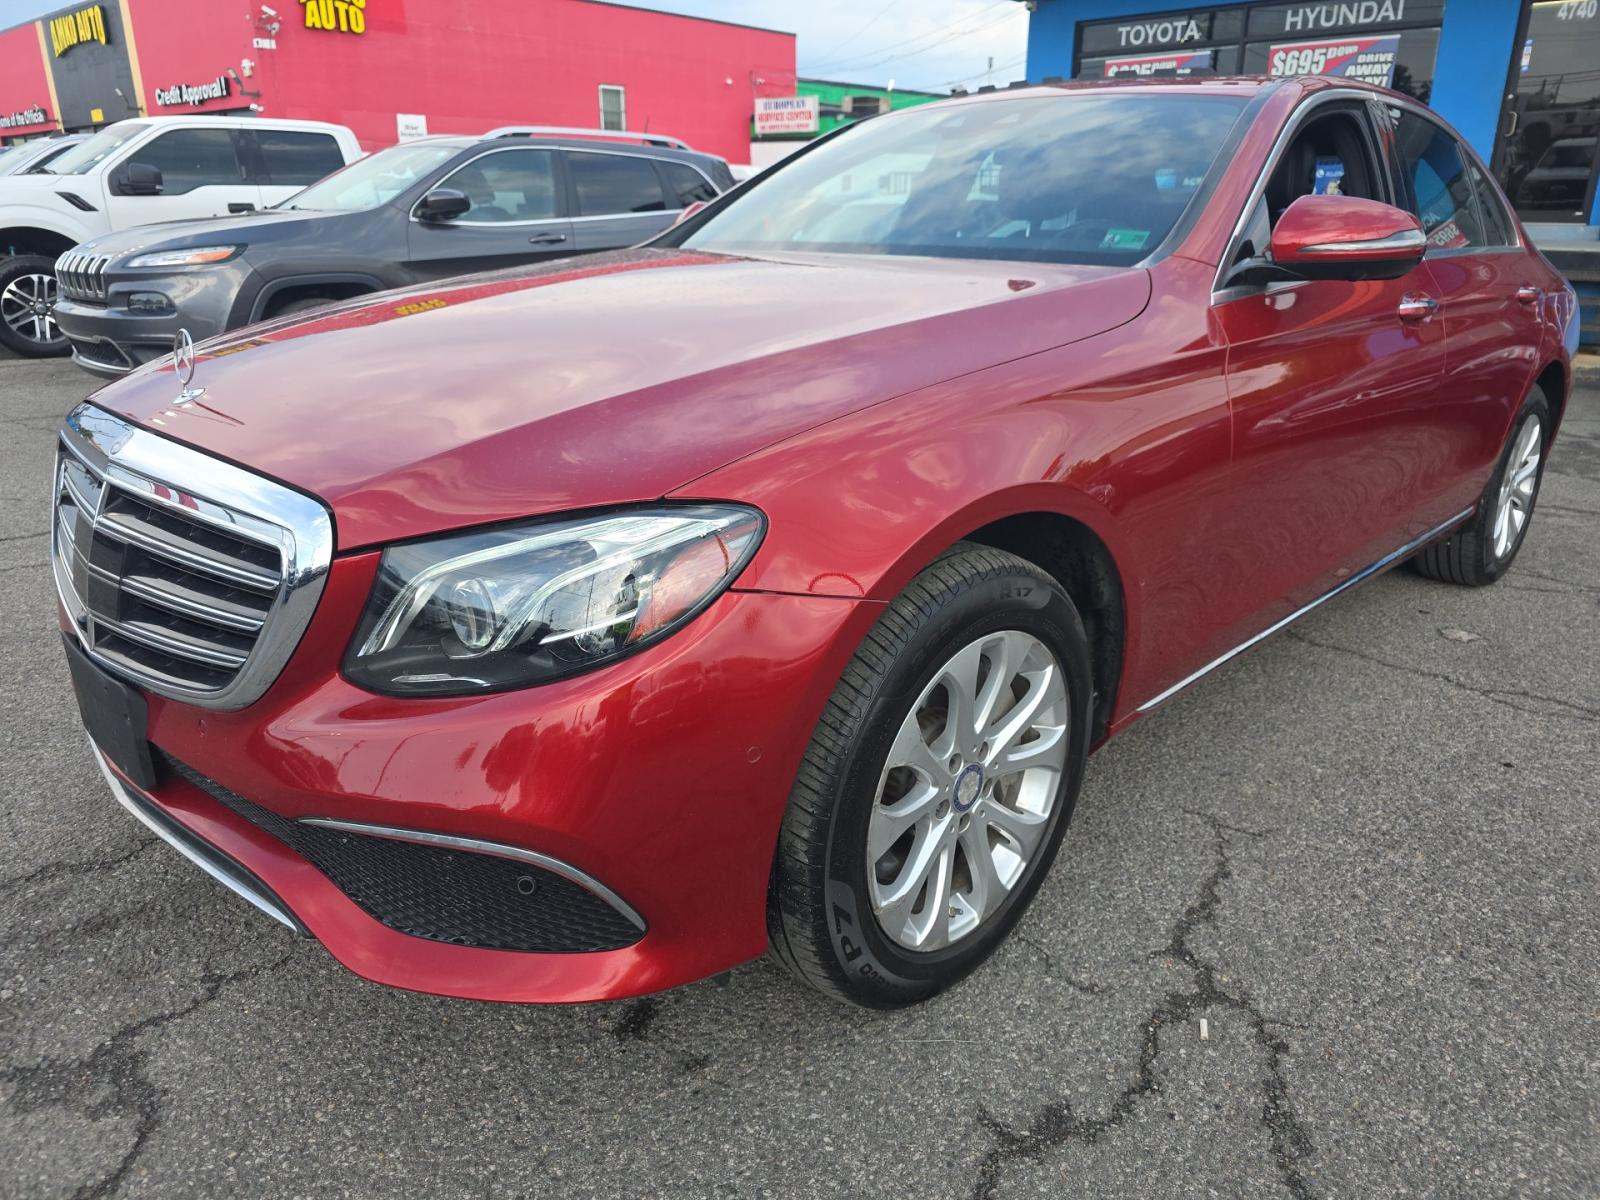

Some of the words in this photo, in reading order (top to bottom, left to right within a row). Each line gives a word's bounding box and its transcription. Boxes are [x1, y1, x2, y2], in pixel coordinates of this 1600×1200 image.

[305, 0, 366, 33] AUTO
[1284, 0, 1406, 31] HYUNDAI
[1557, 0, 1598, 20] 4740
[76, 4, 106, 45] AUTO
[1118, 20, 1200, 46] TOYOTA
[1270, 49, 1327, 76] $695
[1344, 63, 1392, 76] AWAY
[1357, 52, 1394, 64] DRIVE
[155, 86, 182, 106] Credit
[181, 76, 228, 106] Approval!
